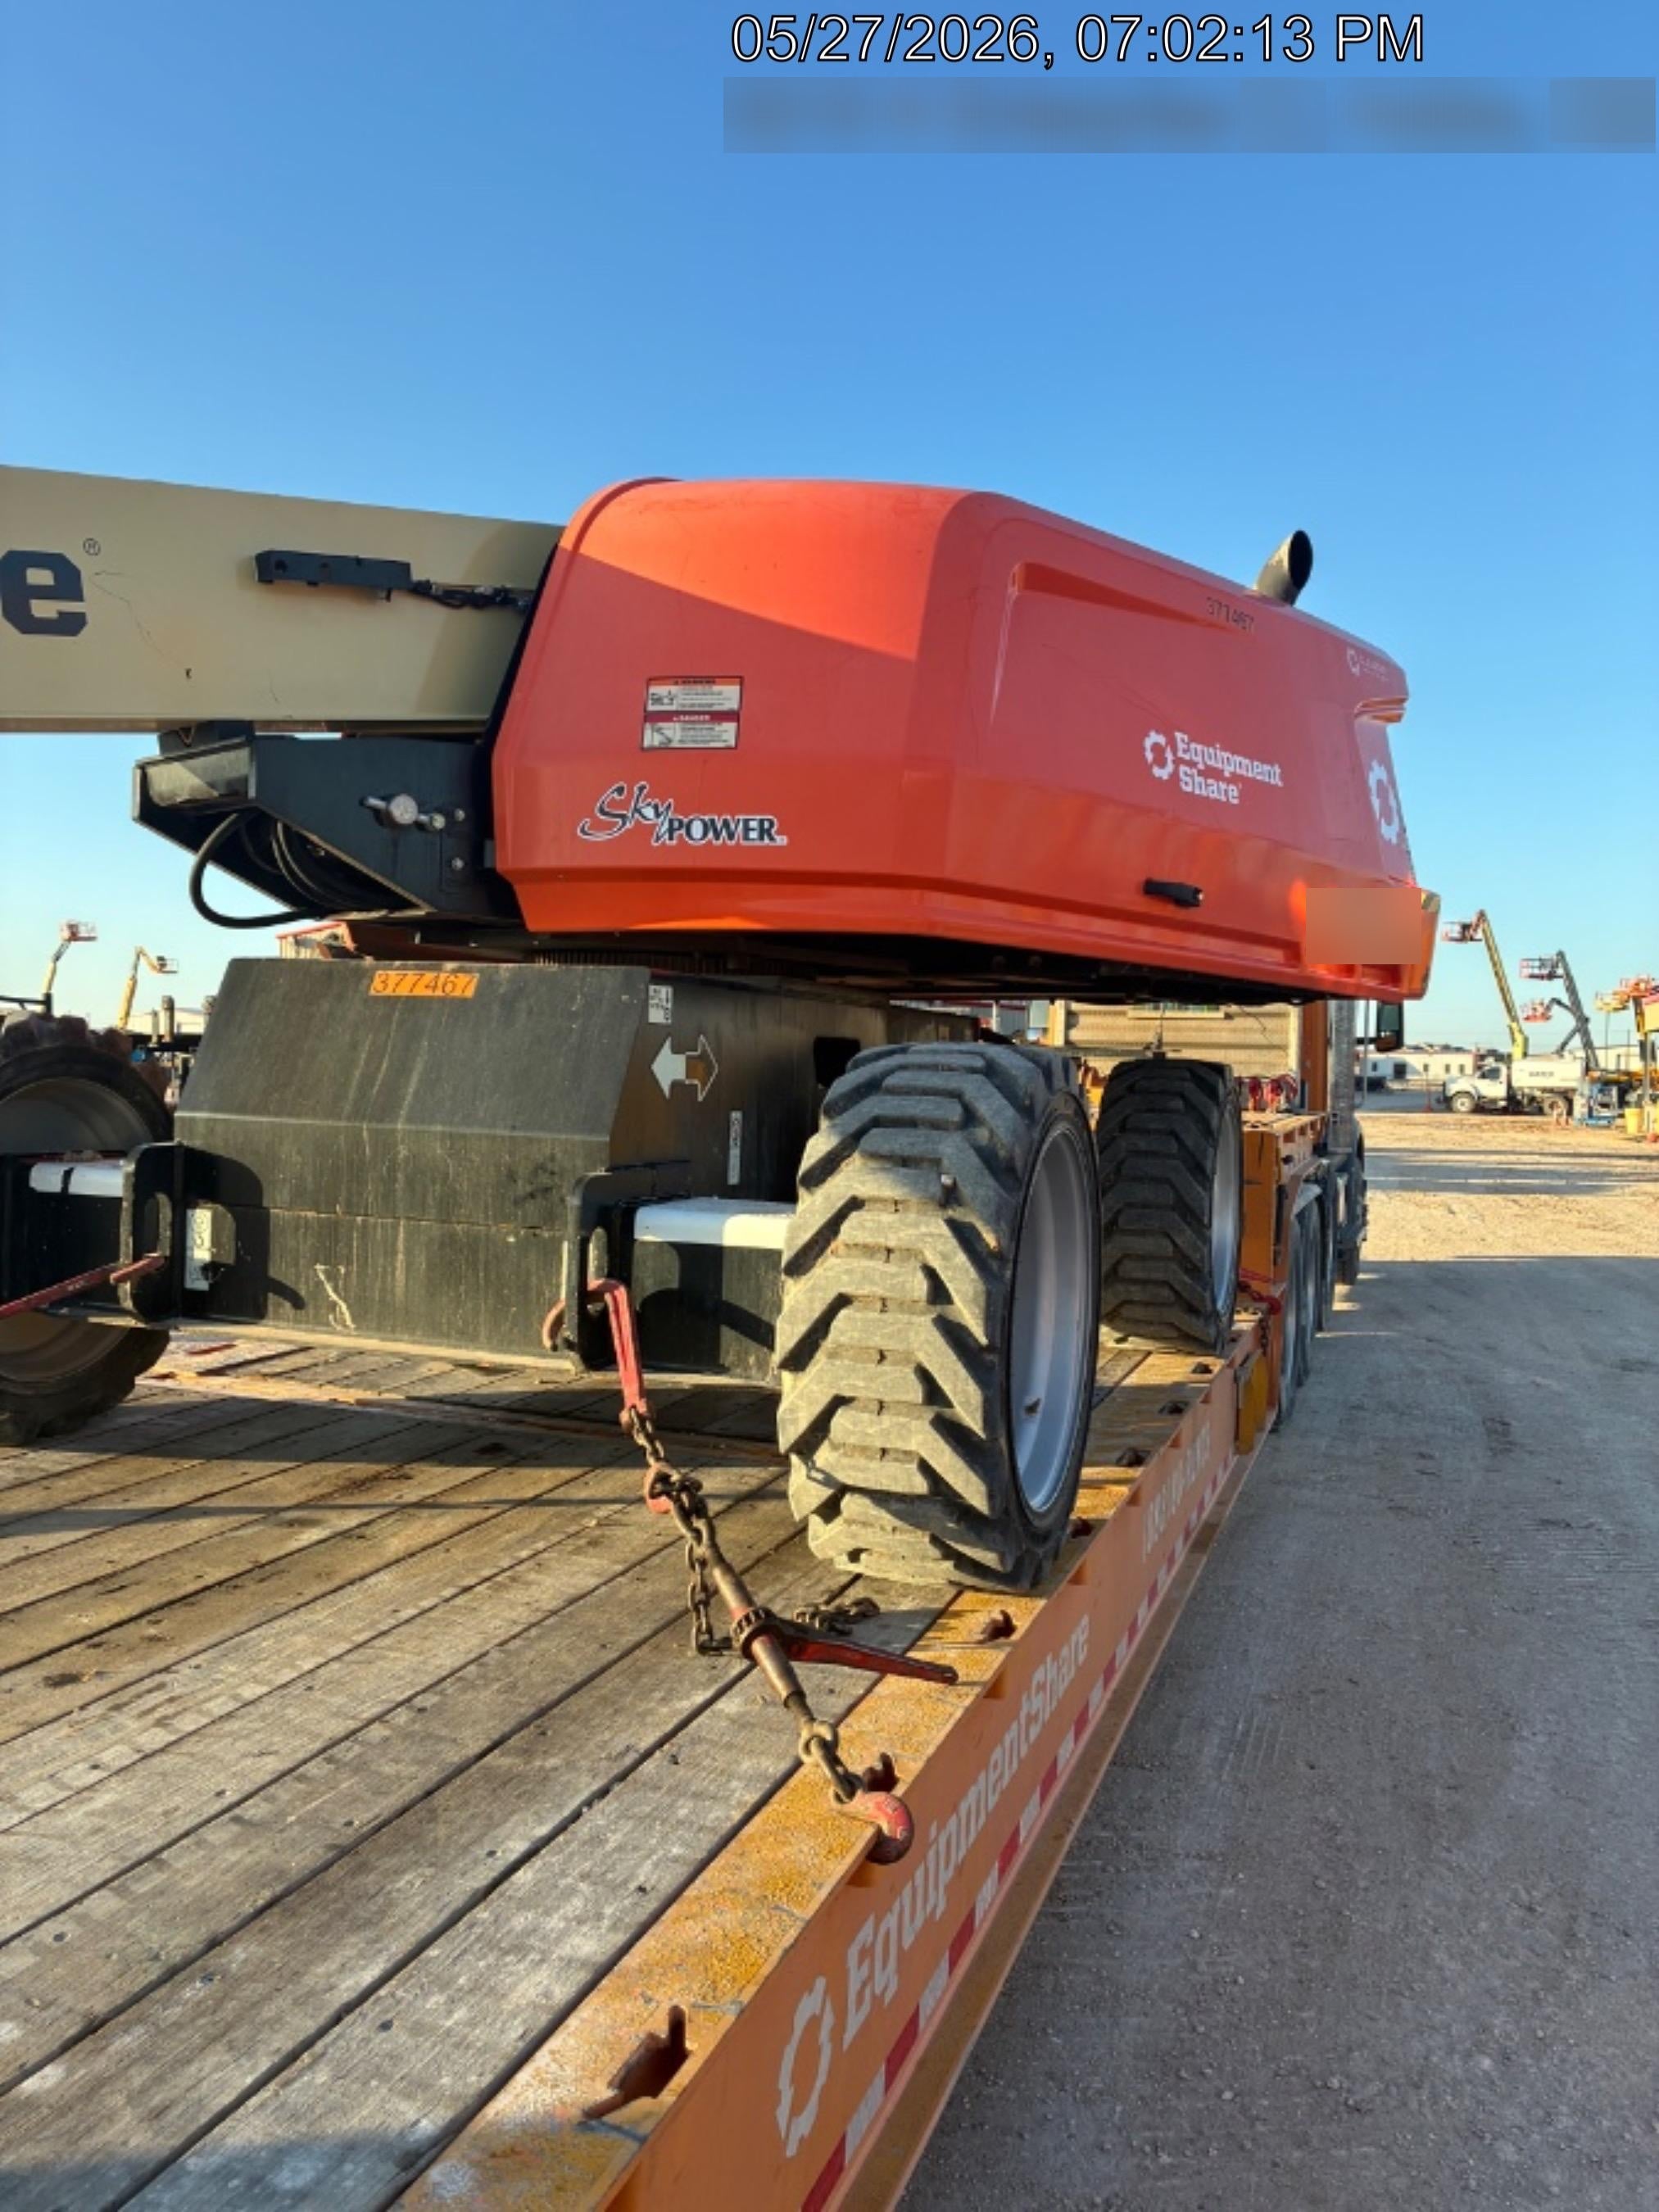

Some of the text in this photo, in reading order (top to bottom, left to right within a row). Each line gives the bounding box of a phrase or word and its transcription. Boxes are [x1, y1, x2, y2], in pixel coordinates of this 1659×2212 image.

[1174, 731, 1284, 786] Equipment
[1179, 764, 1240, 805] Share
[373, 972, 474, 995] 377467
[842, 1613, 1090, 2052] EquipmentShare
